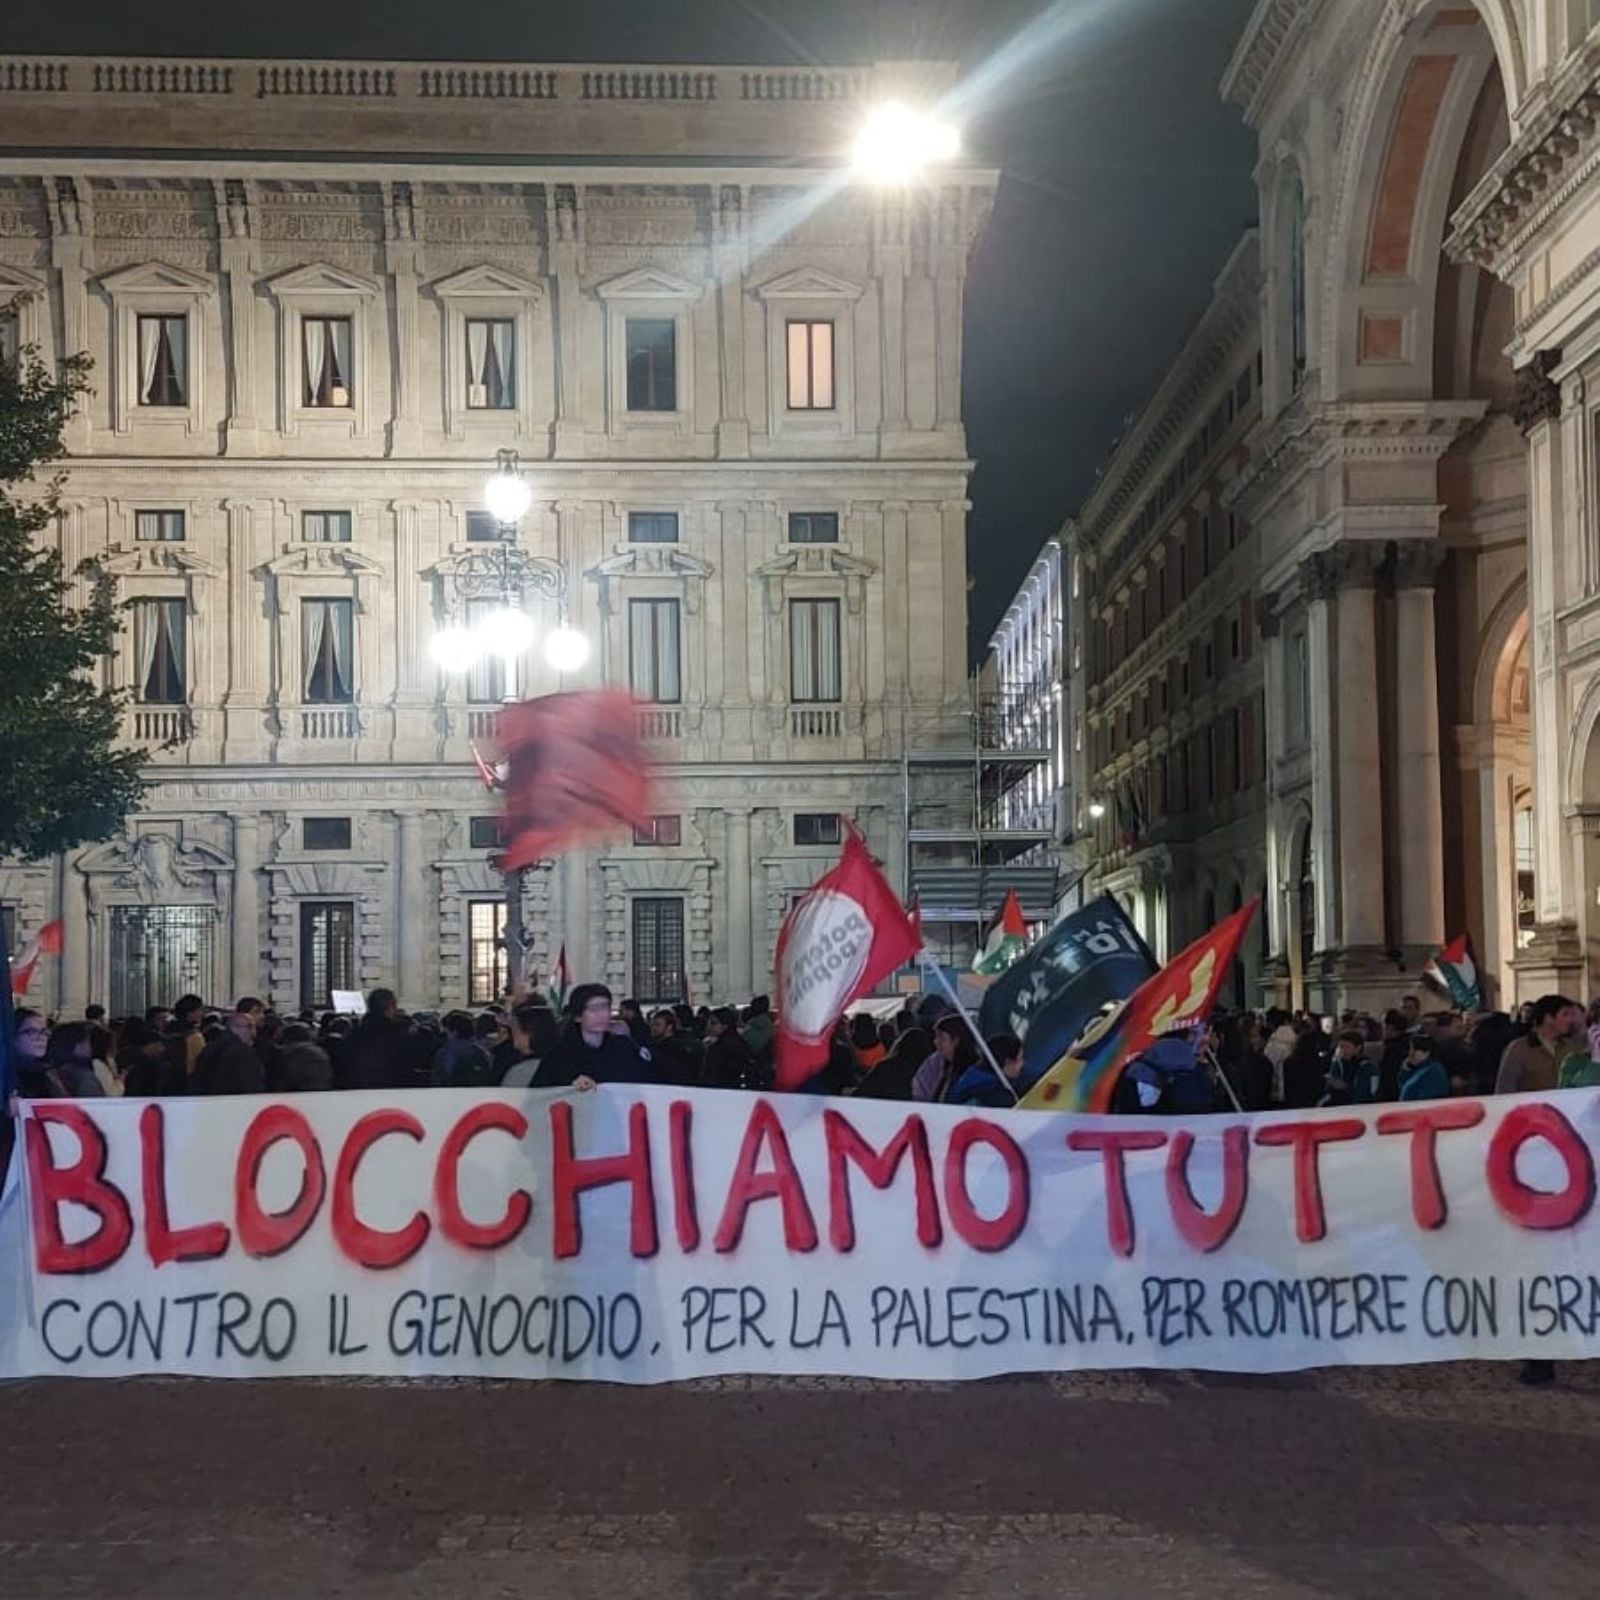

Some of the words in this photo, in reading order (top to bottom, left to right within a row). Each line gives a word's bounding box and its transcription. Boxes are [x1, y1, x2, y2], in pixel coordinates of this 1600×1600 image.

[26, 1099, 1030, 1274] BLOCCHIAMO
[1066, 1102, 1597, 1258] TUTTO
[41, 1291, 297, 1363] CONTRO
[329, 1294, 366, 1355] IL
[682, 1286, 774, 1353] PER
[790, 1289, 851, 1349] LA
[871, 1285, 1134, 1350] PALESTINA,
[1142, 1276, 1212, 1346] PER
[1222, 1273, 1408, 1341] ROMPERE
[1422, 1274, 1498, 1338] CON
